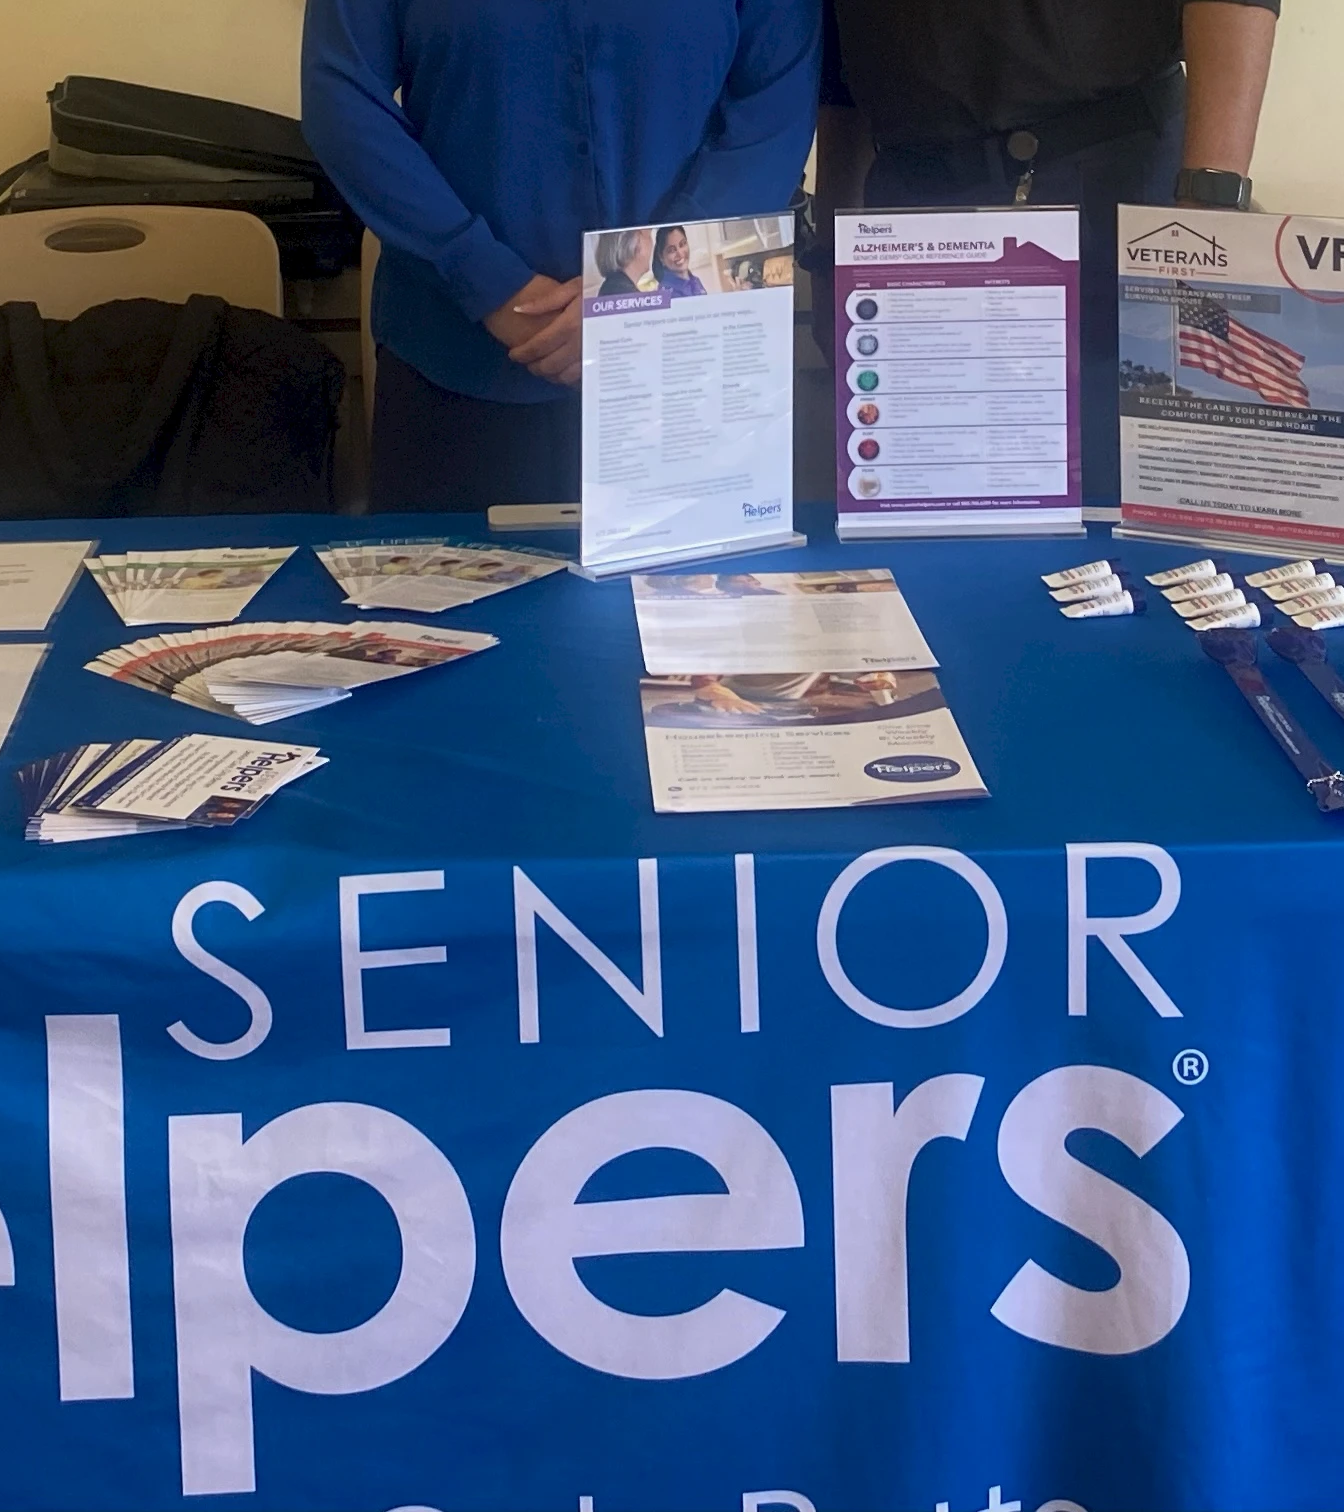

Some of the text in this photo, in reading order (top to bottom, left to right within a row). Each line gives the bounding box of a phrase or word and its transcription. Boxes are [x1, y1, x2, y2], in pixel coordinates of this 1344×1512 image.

[853, 241, 995, 253] ALZHEIMER'S & DEMENTIA
[1127, 241, 1228, 267] VETERANS
[1159, 266, 1196, 277] FIRST
[592, 295, 663, 312] OUR SERVICES
[1184, 401, 1203, 409] THE
[1206, 403, 1231, 413] CARE
[1235, 406, 1255, 415] YOU
[1322, 415, 1342, 424] THE
[1213, 414, 1225, 422] OF
[1228, 416, 1255, 426] YOUR
[744, 503, 782, 517] Helpers
[219, 751, 286, 792] Helpers
[166, 840, 1184, 1061] SENIOR
